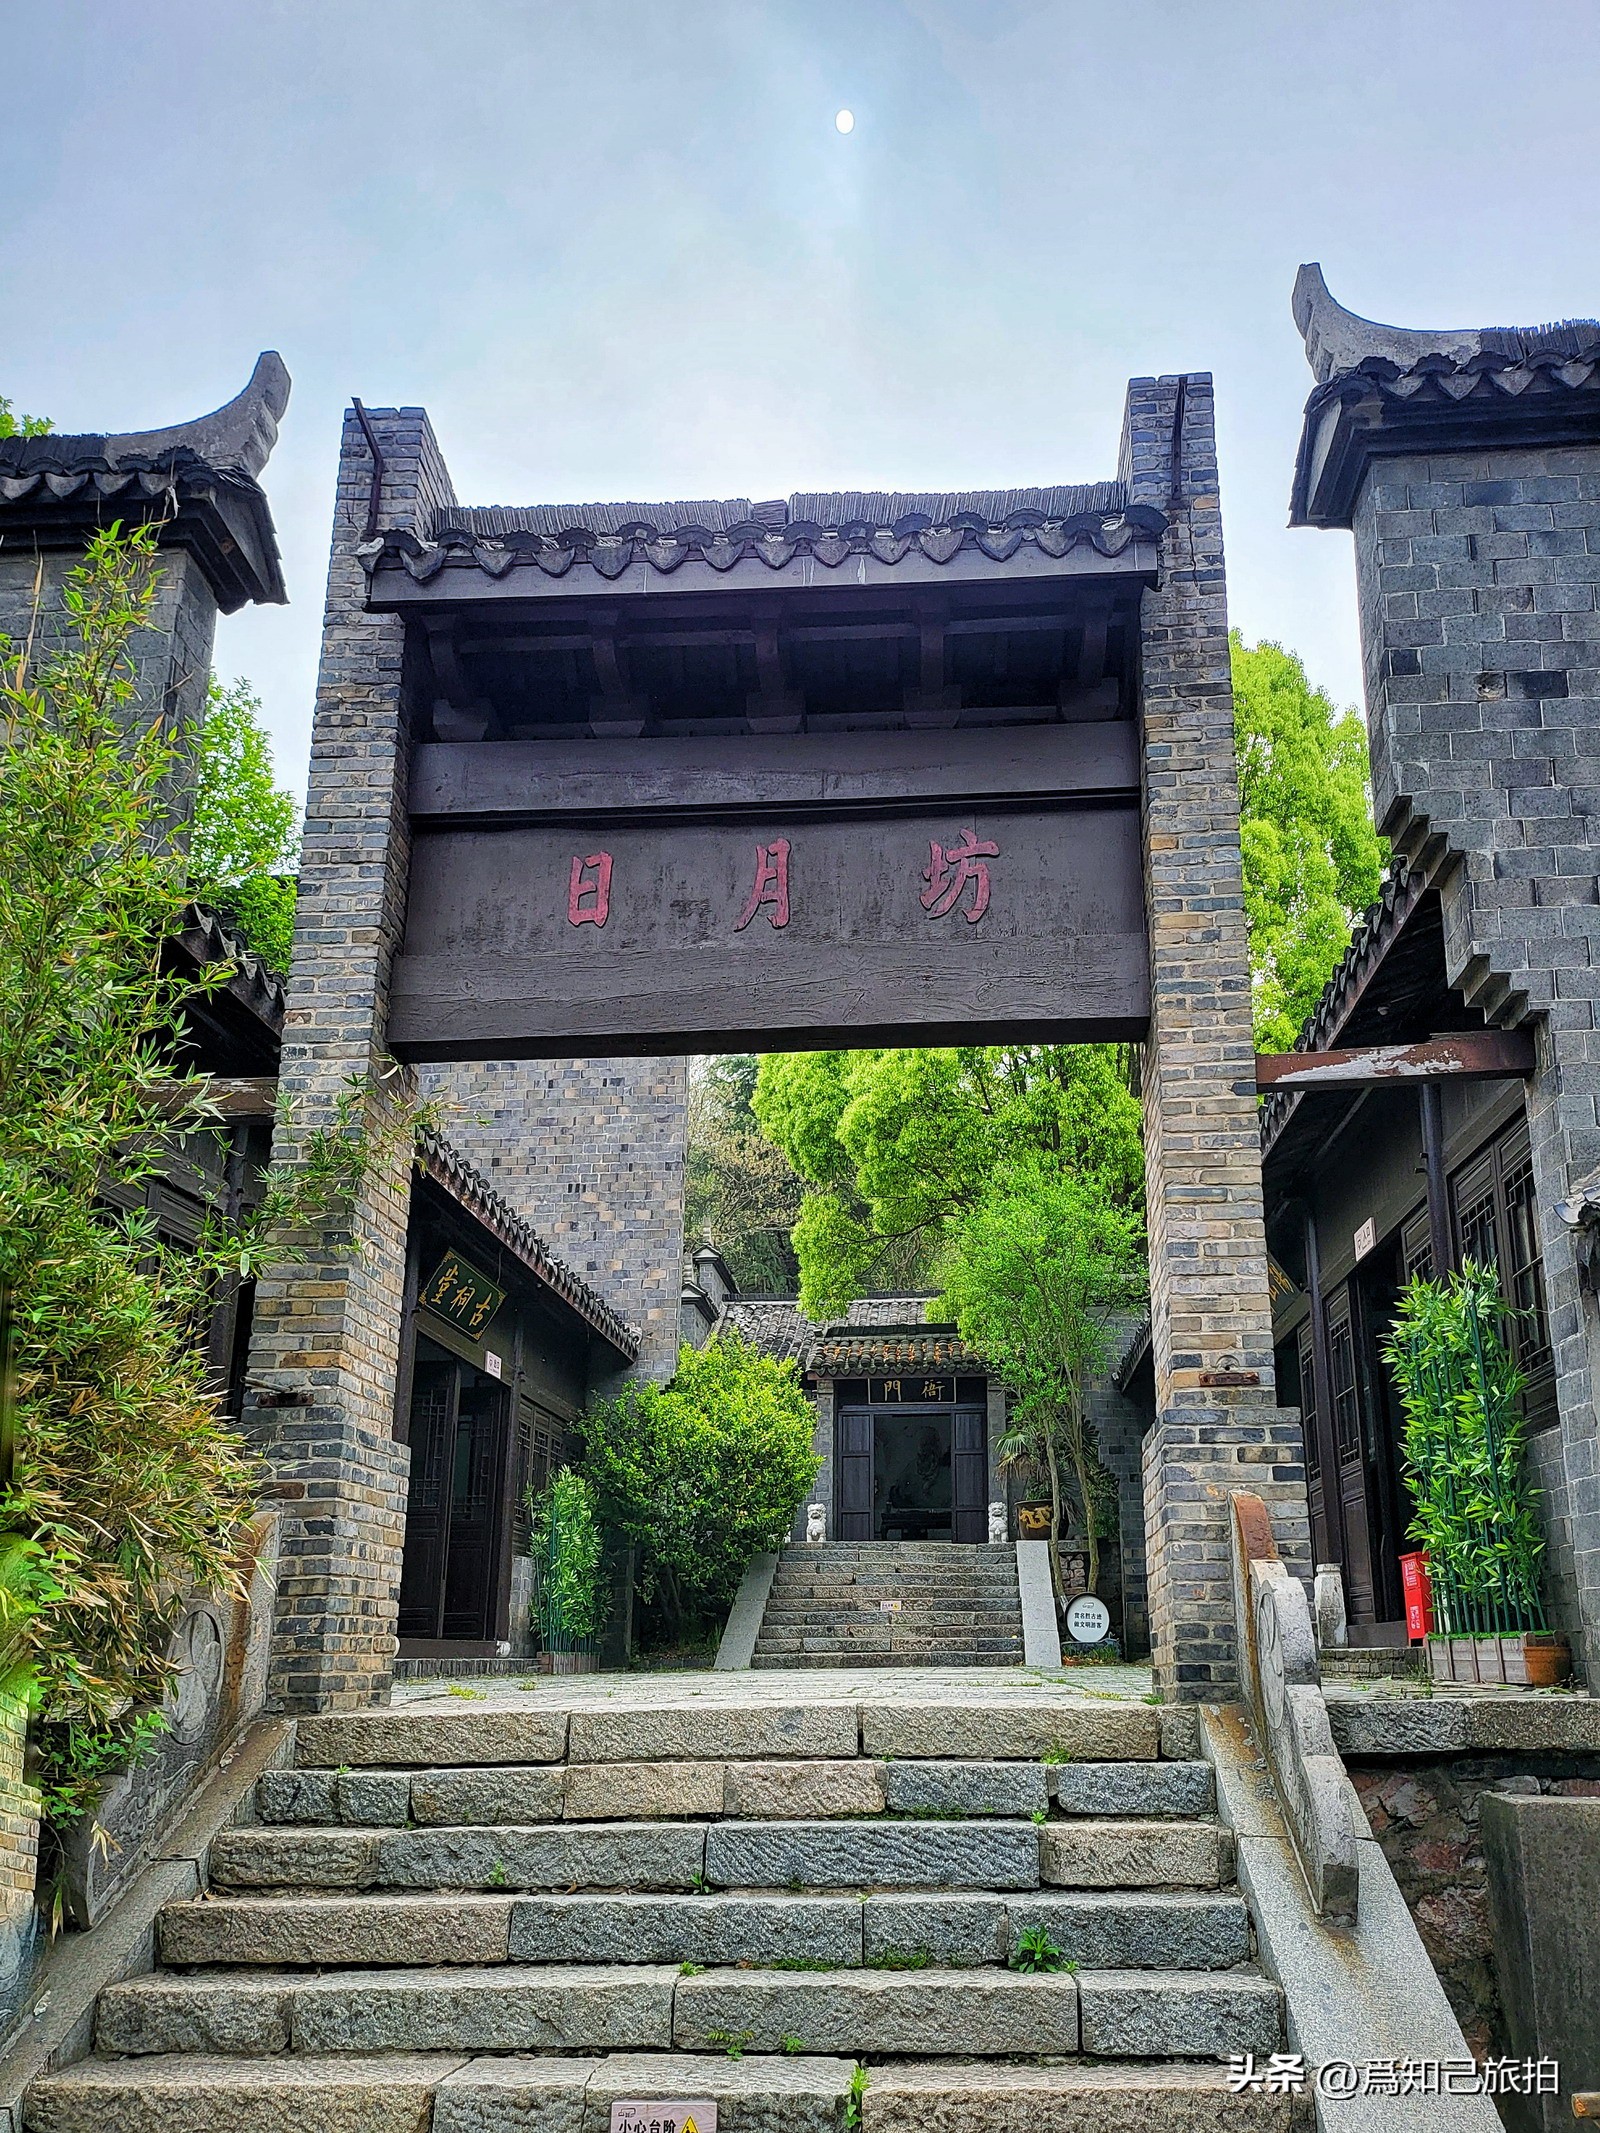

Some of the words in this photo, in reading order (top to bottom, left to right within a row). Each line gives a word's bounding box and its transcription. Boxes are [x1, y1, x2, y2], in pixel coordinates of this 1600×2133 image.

[567, 828, 999, 929] 日月坊
[619, 2119, 676, 2133] 小心台阶
